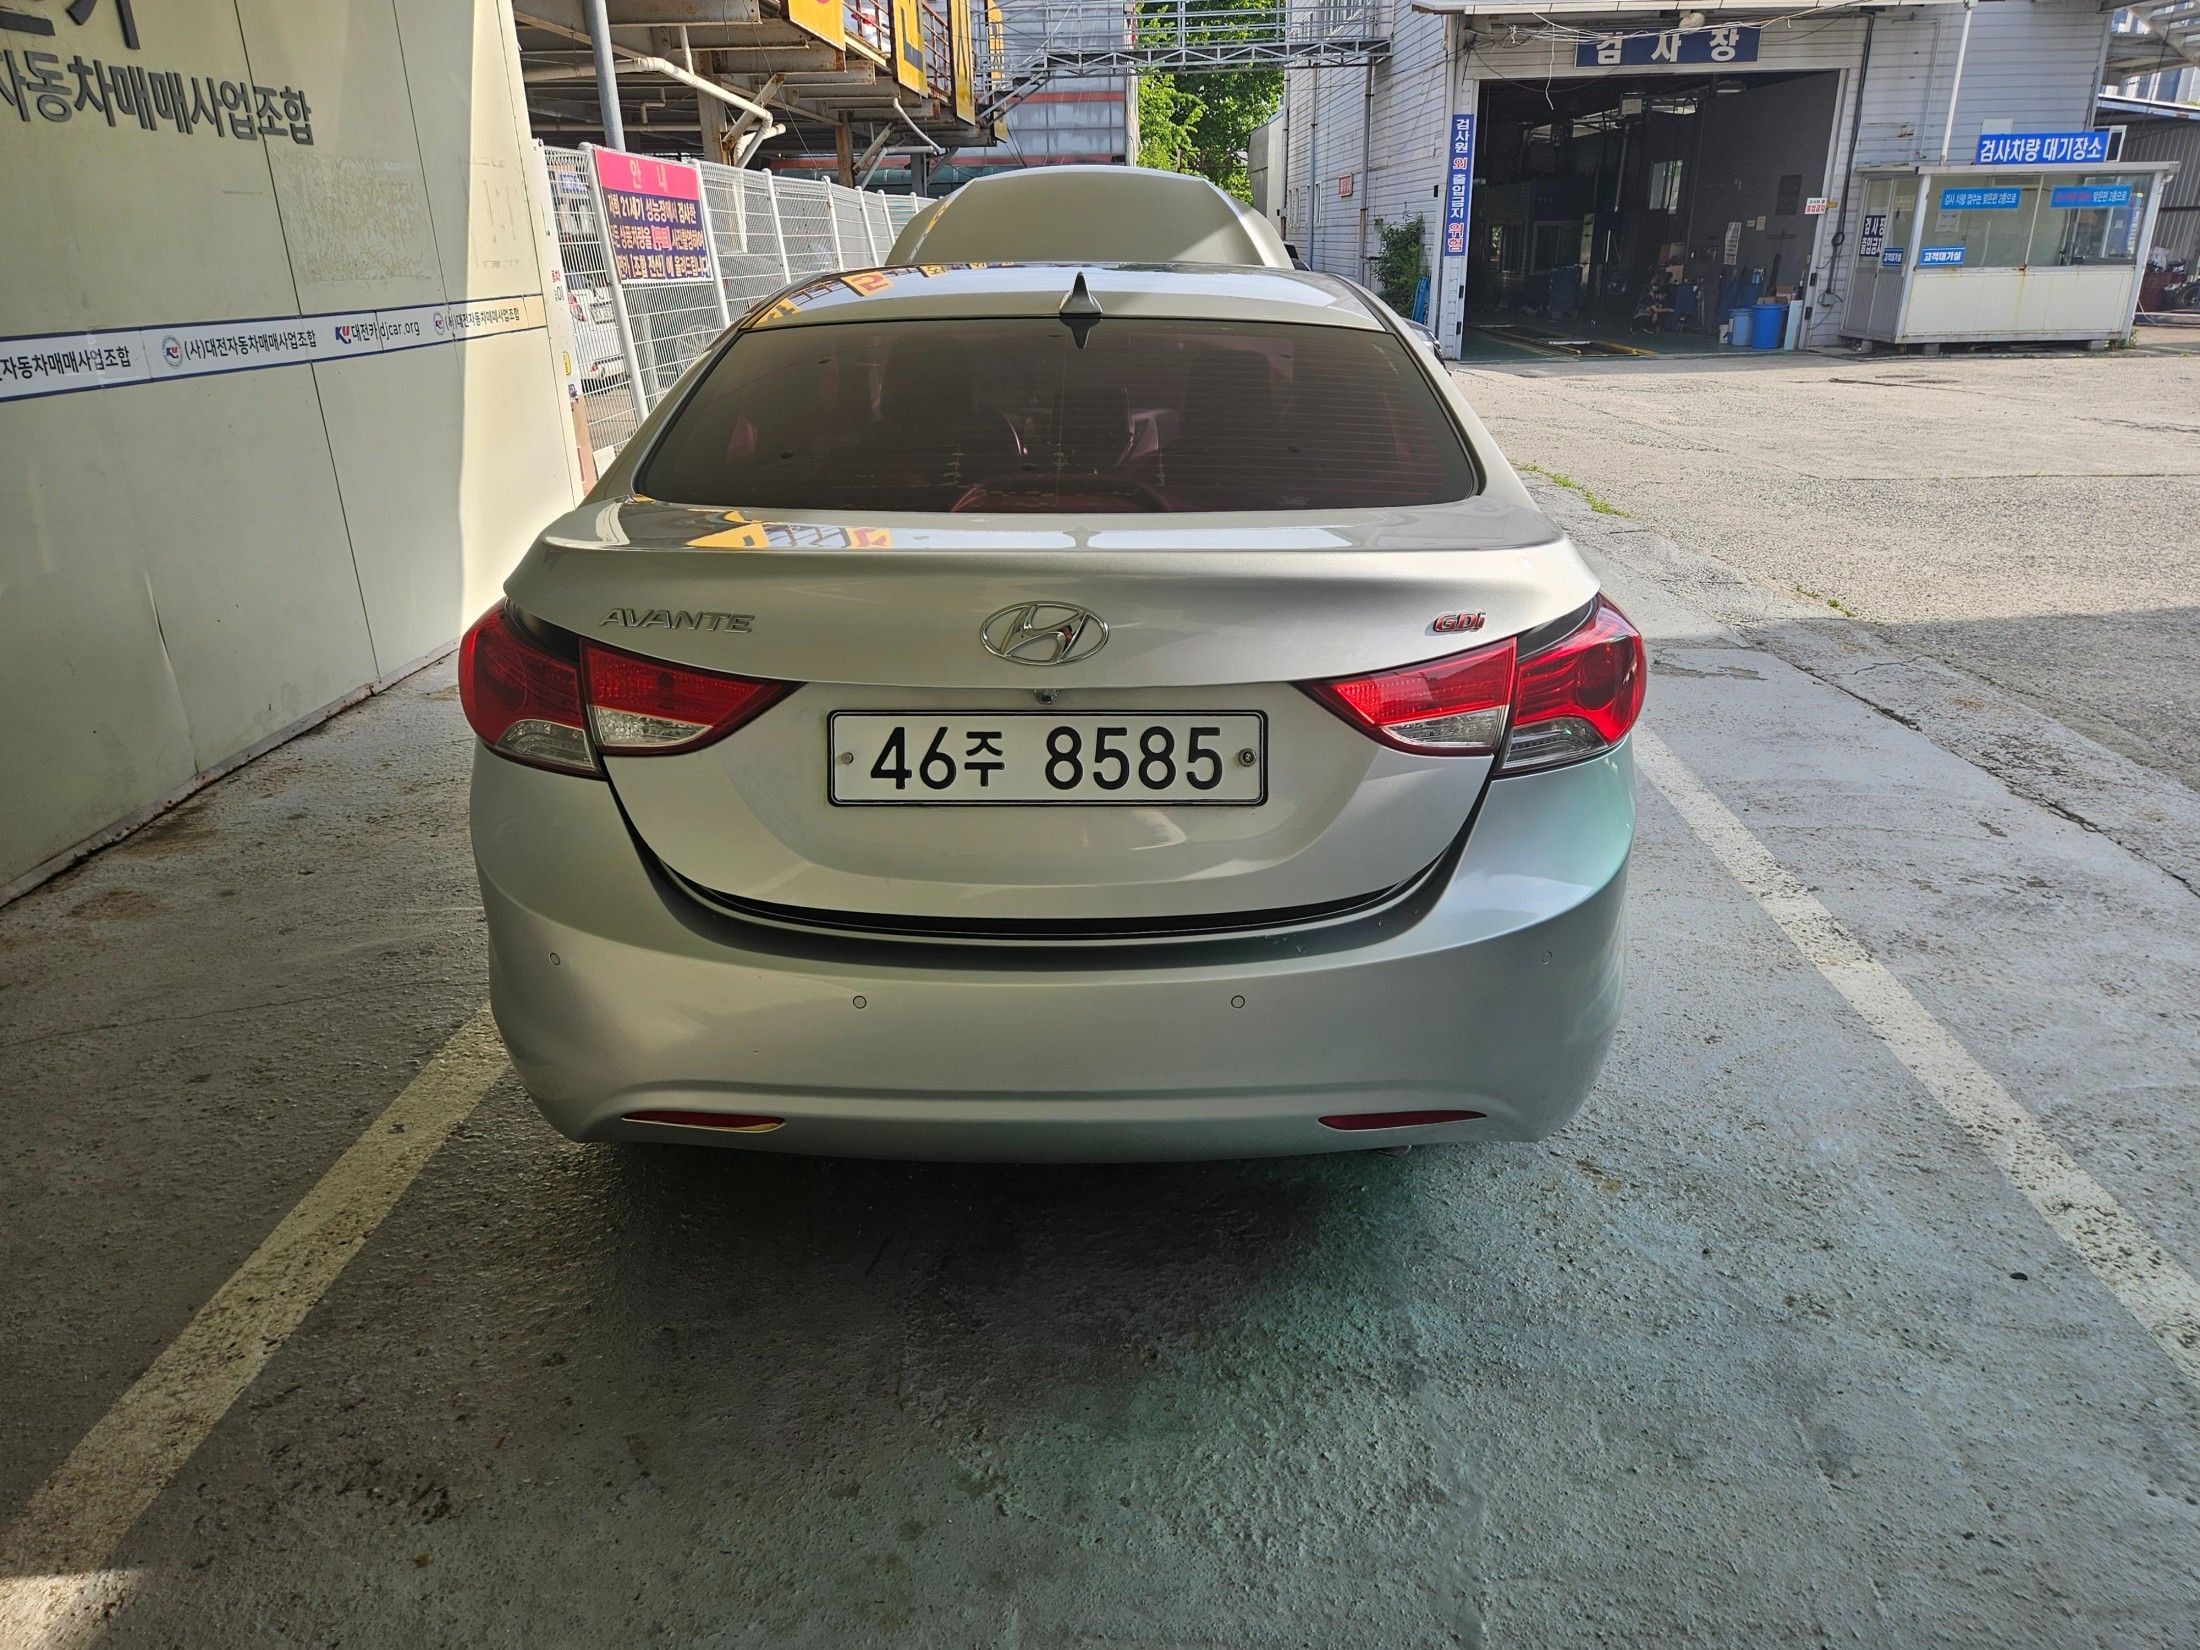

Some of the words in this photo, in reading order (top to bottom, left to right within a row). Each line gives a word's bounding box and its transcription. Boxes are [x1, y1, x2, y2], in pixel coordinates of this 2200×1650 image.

[1454, 118, 1470, 154] 검사원
[1980, 138, 2041, 162] 검사차량
[2042, 137, 2103, 161] 대기장소
[1453, 157, 1468, 170] 외
[1450, 174, 1466, 219] 출입금지
[1447, 222, 1465, 253] 위험
[1923, 251, 1962, 262] 고객대기실
[184, 329, 317, 361] (사)대전자동차매매사업조합
[0, 346, 131, 381] 자동차매매사업조합
[599, 608, 755, 633] AVANTE
[870, 726, 1005, 790] 46주
[1045, 726, 1223, 790] 8585
